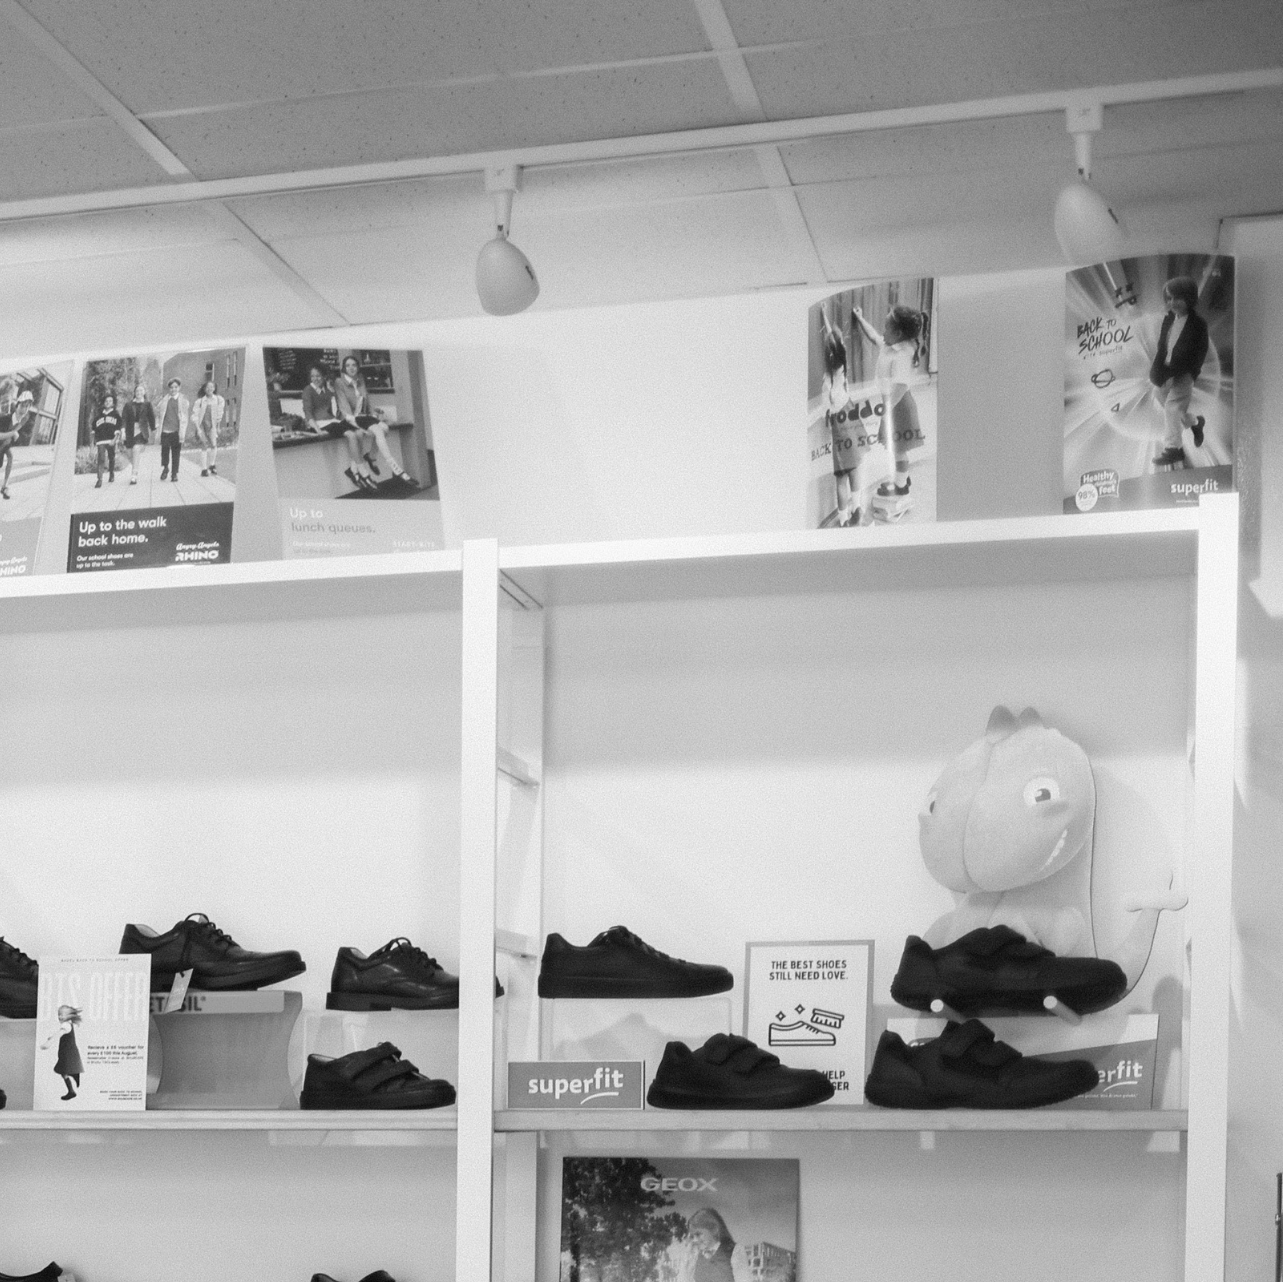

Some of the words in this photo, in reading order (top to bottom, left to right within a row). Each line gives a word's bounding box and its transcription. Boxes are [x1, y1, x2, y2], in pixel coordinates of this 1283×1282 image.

[1077, 317, 1103, 339] BACK
[1106, 319, 1117, 330] TO
[1079, 325, 1134, 354] SCHOOL
[825, 400, 886, 428] froddo
[811, 443, 832, 461] BACK
[836, 438, 853, 451] TO
[1083, 471, 1115, 484] Healthy
[1099, 484, 1116, 495] feet
[1171, 478, 1219, 496] superfit
[290, 508, 307, 520] Up
[311, 508, 324, 519] to
[79, 521, 96, 534] Up
[99, 521, 112, 531] to
[115, 519, 135, 530] the
[138, 516, 167, 528] walk
[291, 523, 325, 533] lunch
[329, 524, 376, 534] queues.
[78, 534, 108, 547] back
[112, 534, 148, 545] home.
[175, 550, 219, 561] RHINO
[771, 961, 788, 969] THE
[790, 960, 813, 969] BEST
[816, 960, 847, 969] SHOES
[769, 971, 792, 981] STILL
[794, 971, 820, 980] NEED
[822, 971, 848, 980] LOVE.
[528, 1067, 624, 1099] superfit
[640, 1177, 719, 1192] GEOX
